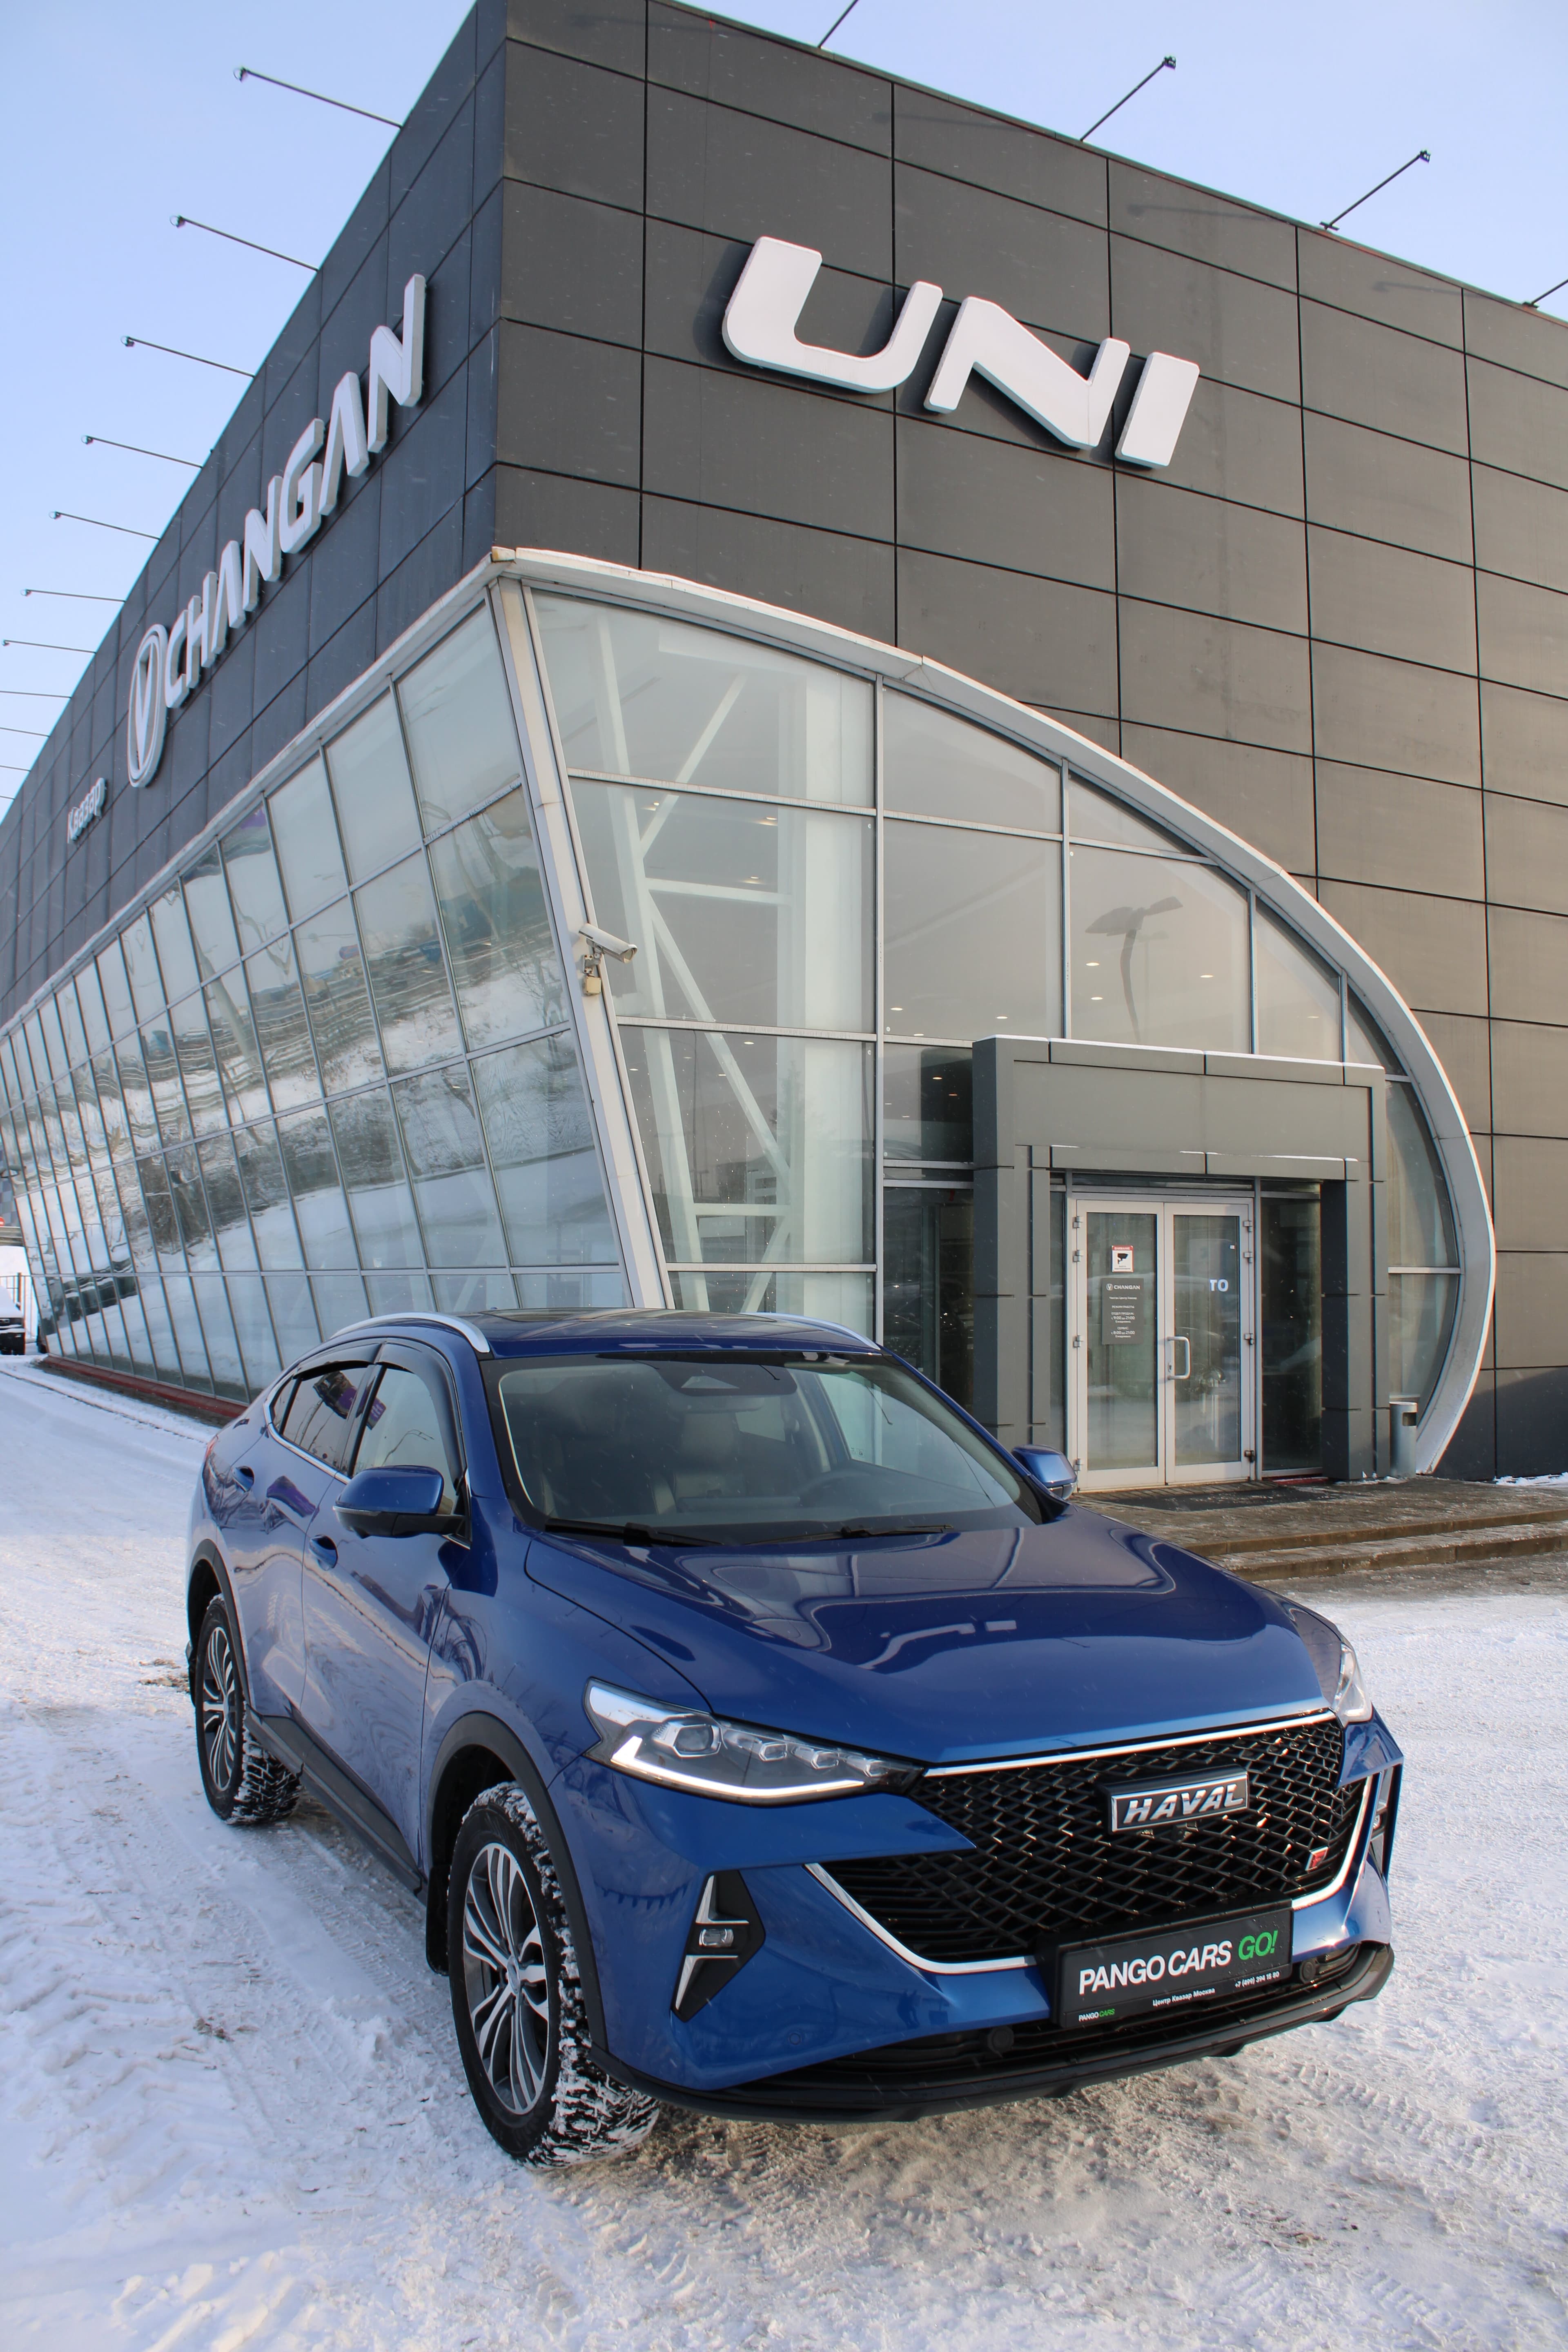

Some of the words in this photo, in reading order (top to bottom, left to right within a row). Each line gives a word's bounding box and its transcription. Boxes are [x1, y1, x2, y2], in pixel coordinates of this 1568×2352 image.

[722, 236, 1200, 468] UNI
[165, 274, 425, 708] CHANGAN
[67, 777, 106, 844] Квазар
[1123, 1784, 1244, 1824] HAVAL
[1079, 1954, 1165, 1995] PANGO
[1168, 1940, 1233, 1976] CARS
[1238, 1930, 1278, 1960] GO!
[1242, 1976, 1255, 1987] (499)
[1256, 1975, 1265, 1983] 394
[1078, 2012, 1099, 2021] PANGO
[1099, 2009, 1115, 2017] CARS
[1152, 1998, 1171, 2007] Центр
[1172, 1993, 1192, 2002] Квазар
[1193, 1988, 1215, 1998] Москва
